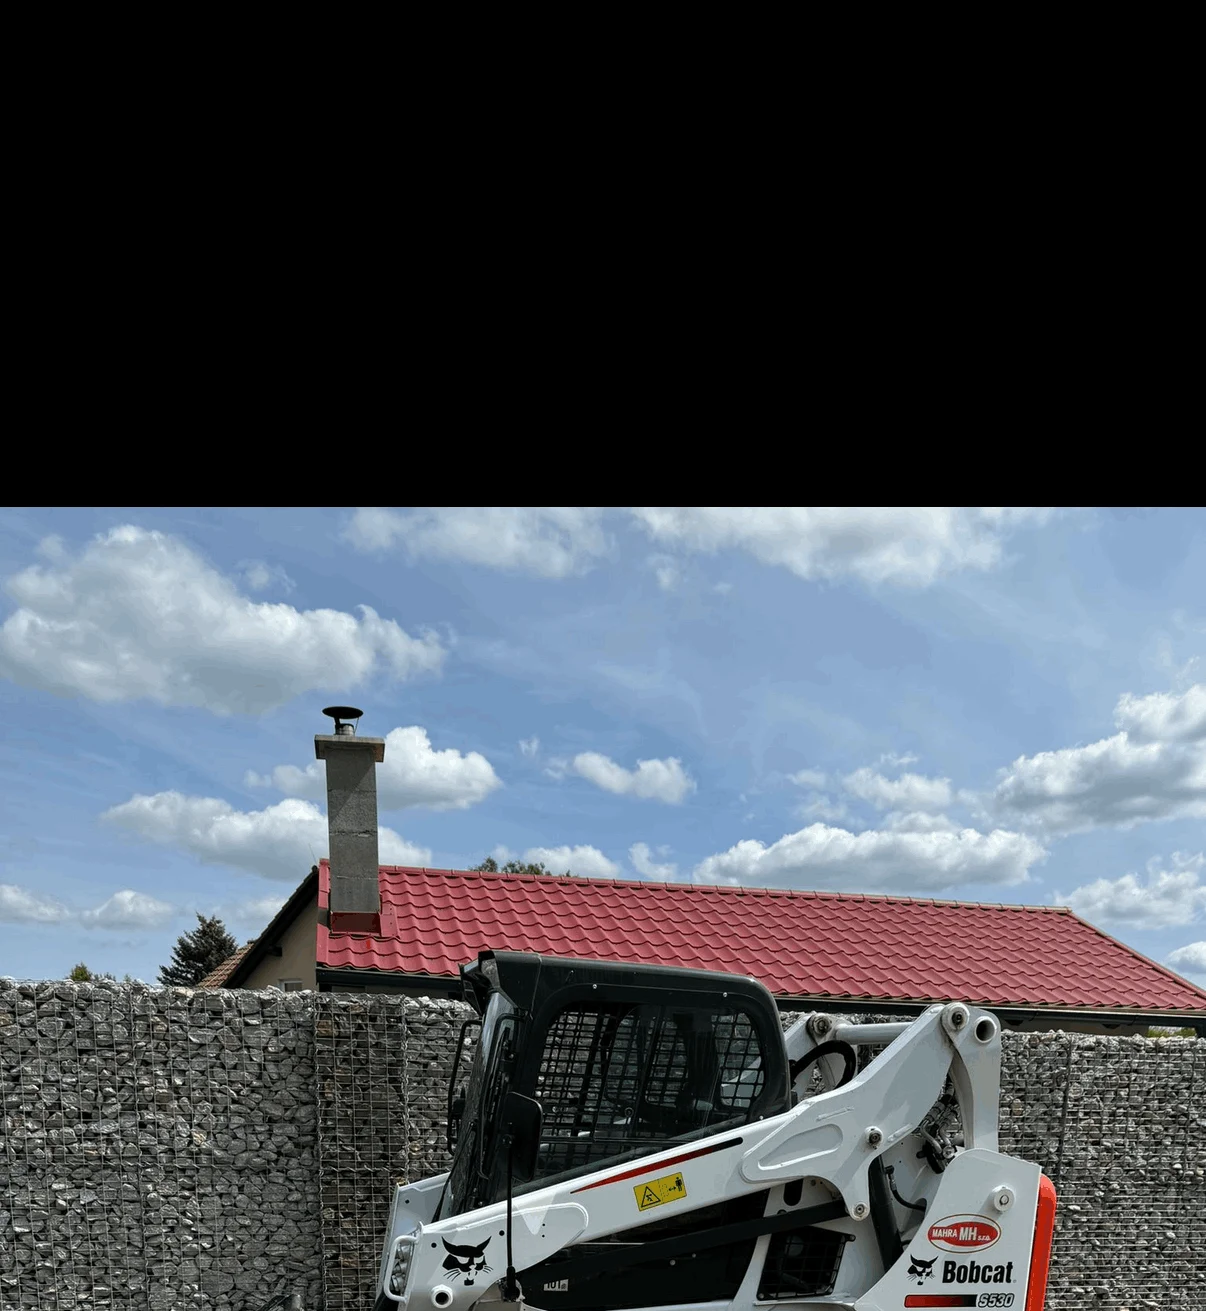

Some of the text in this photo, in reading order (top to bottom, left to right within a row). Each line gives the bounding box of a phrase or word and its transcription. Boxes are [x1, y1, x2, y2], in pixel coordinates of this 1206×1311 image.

[931, 1228, 958, 1238] MAHRA
[959, 1226, 978, 1241] MH
[942, 1260, 1013, 1284] Bobcat
[977, 1293, 1015, 1308] S530
